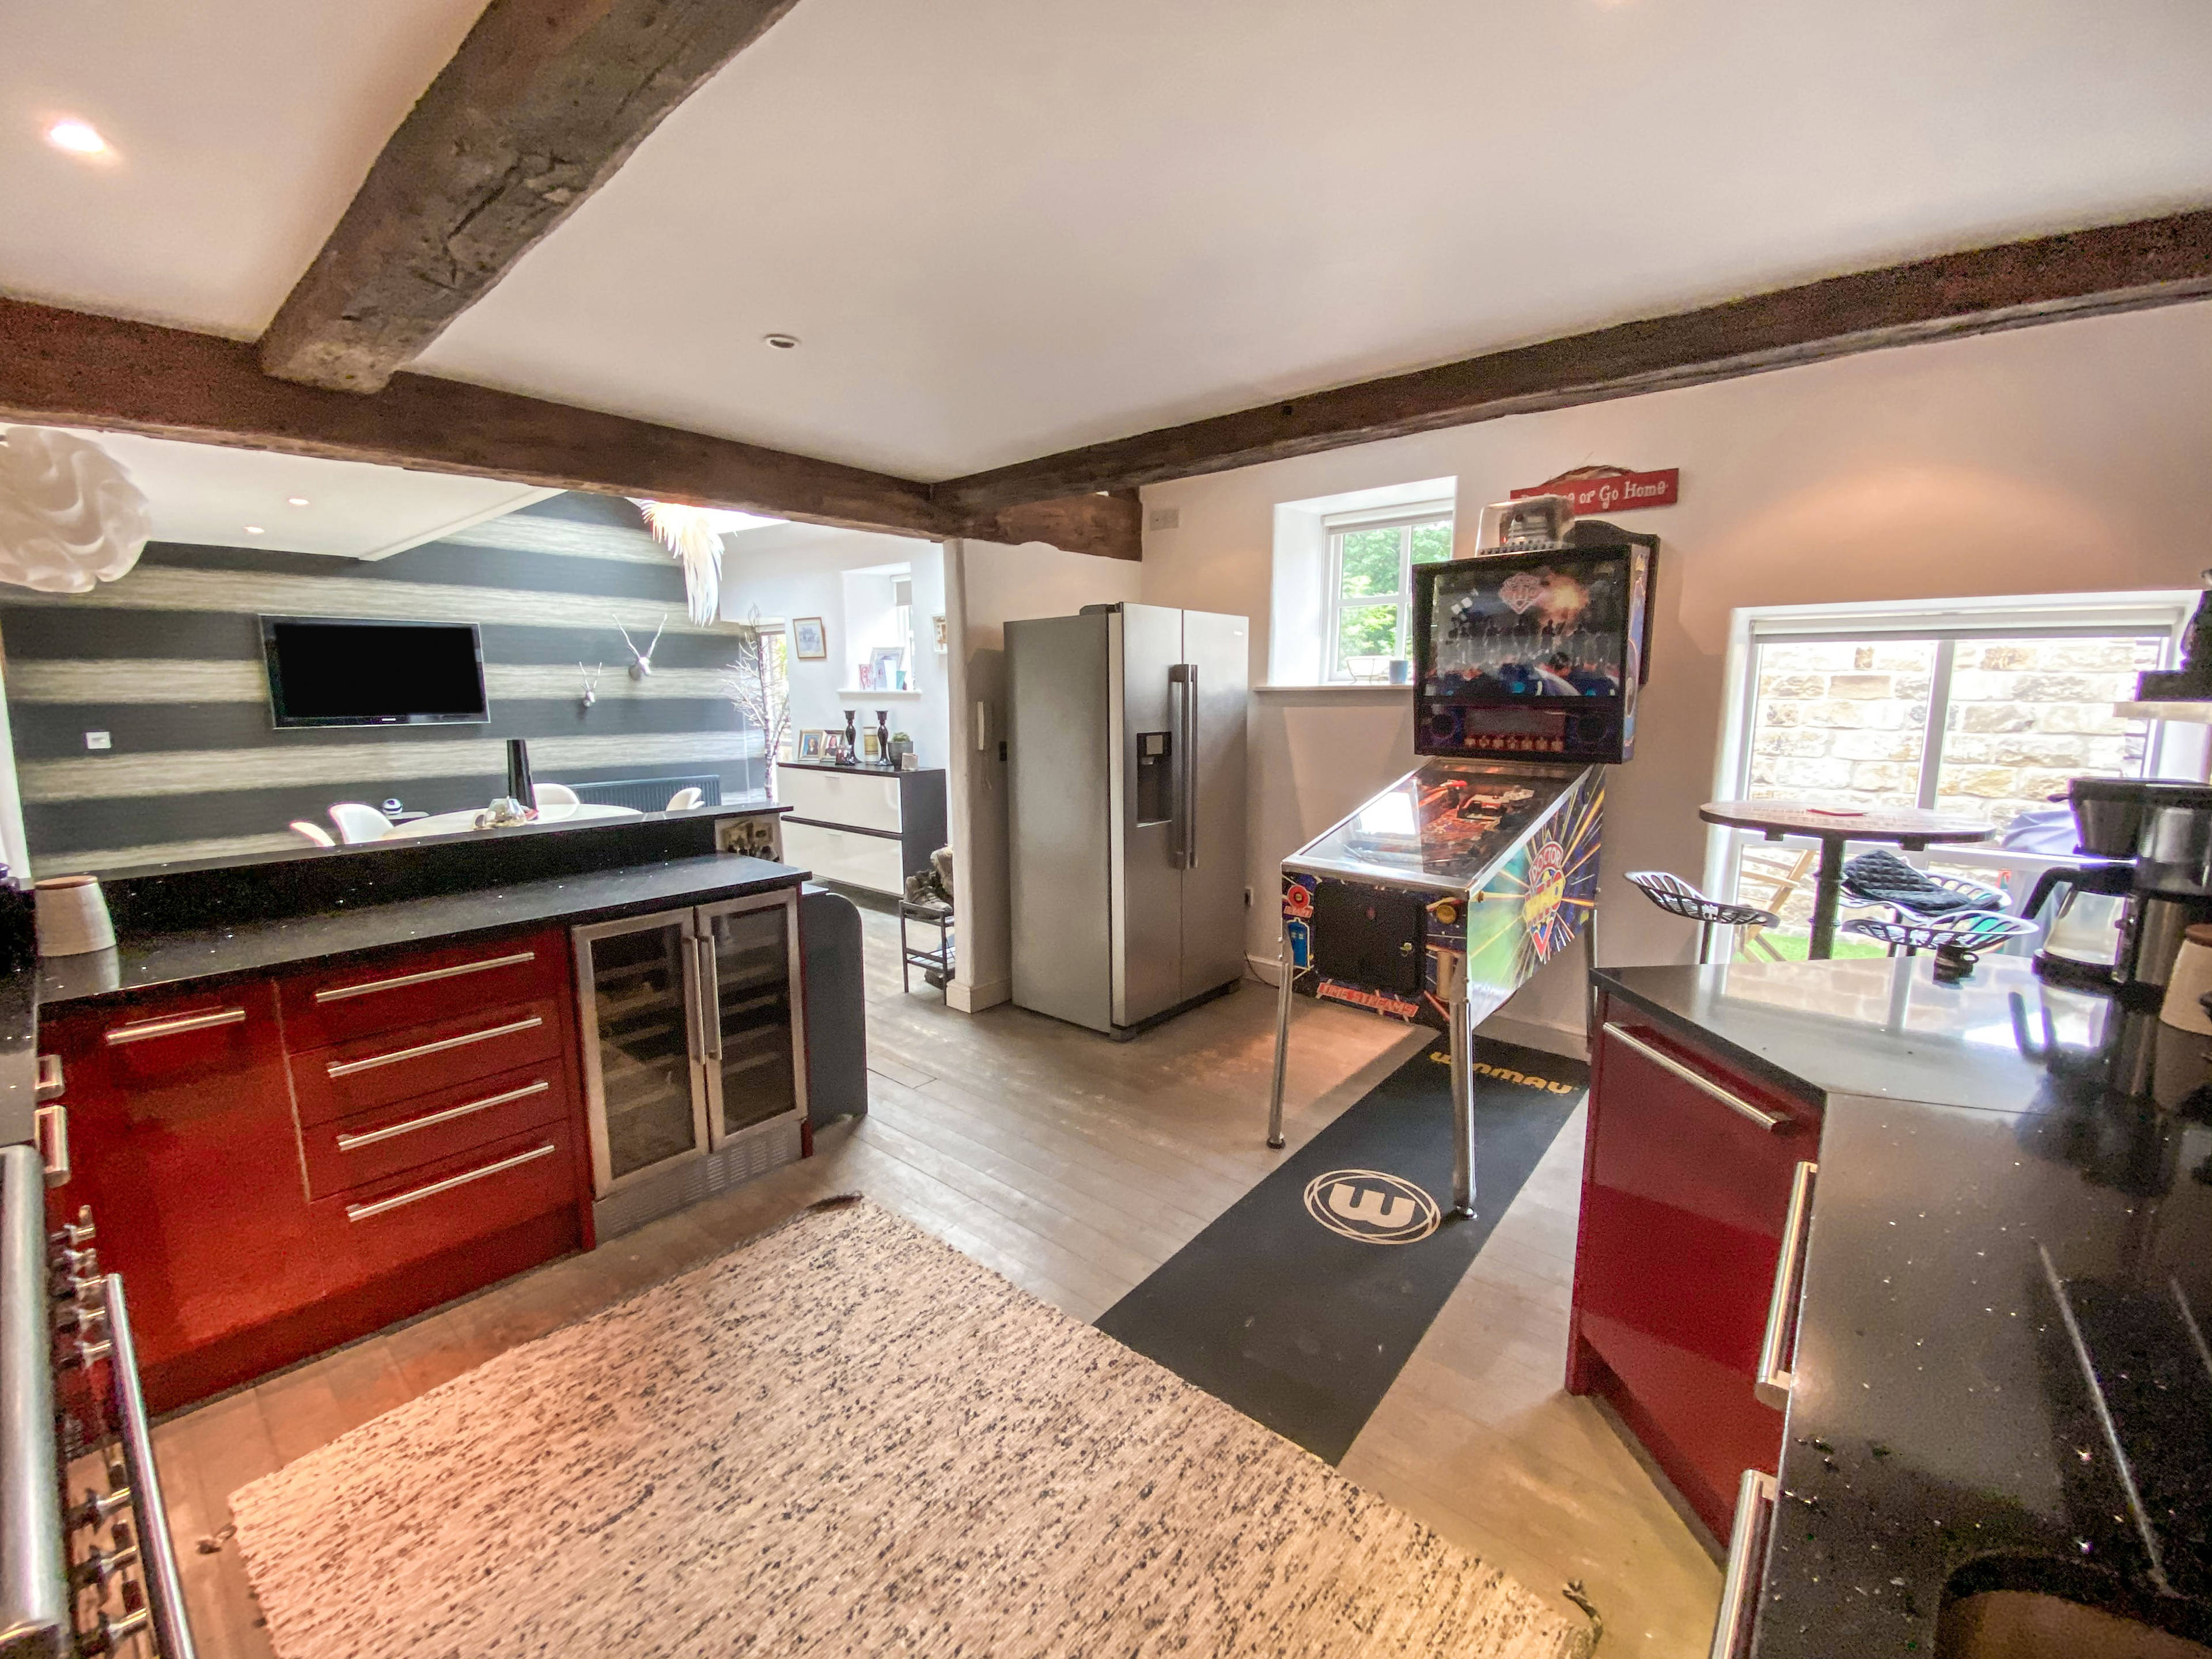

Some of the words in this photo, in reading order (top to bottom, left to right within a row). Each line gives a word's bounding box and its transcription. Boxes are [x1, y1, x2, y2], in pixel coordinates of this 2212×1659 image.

[1580, 490, 1595, 504] or
[1599, 484, 1619, 509] Go
[1624, 480, 1666, 499] Home
[1531, 847, 1561, 881] DOCTOR
